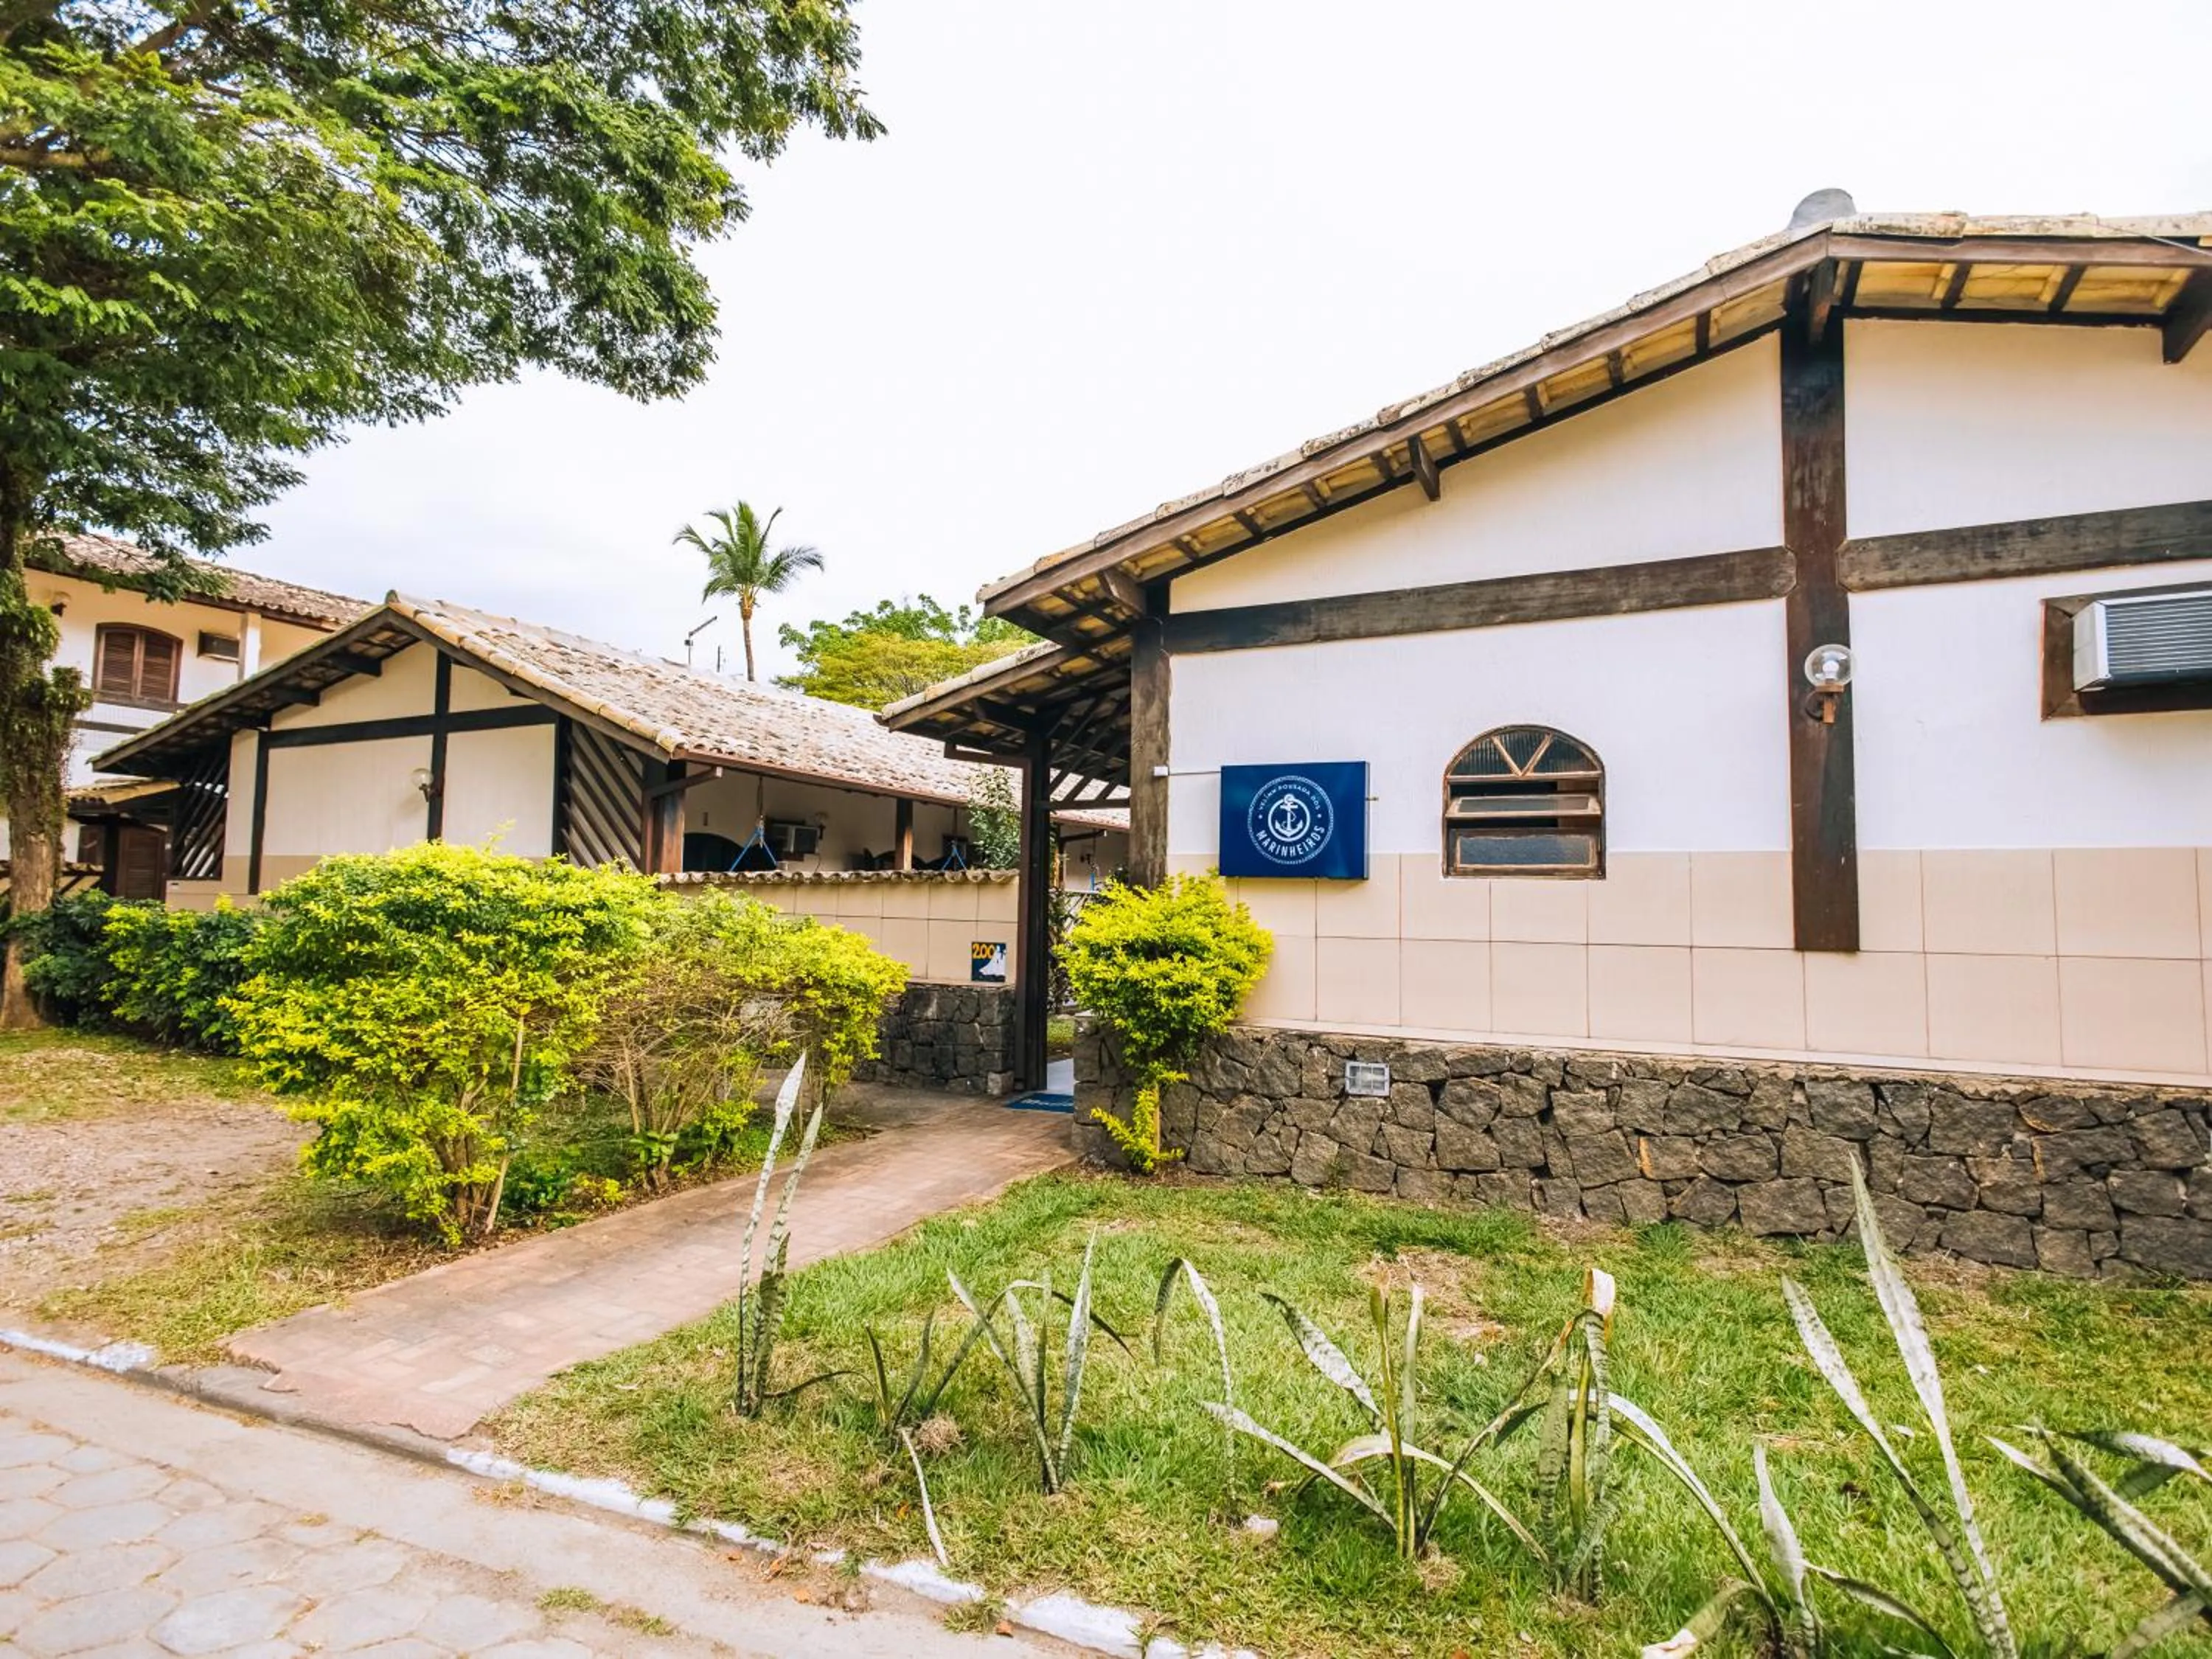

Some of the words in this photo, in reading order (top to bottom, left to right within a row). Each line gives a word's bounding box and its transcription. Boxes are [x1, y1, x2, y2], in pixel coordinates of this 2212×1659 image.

[1278, 784, 1310, 796] POUSADA
[1310, 796, 1321, 810] DOS
[1256, 825, 1325, 858] MARINHEIROS
